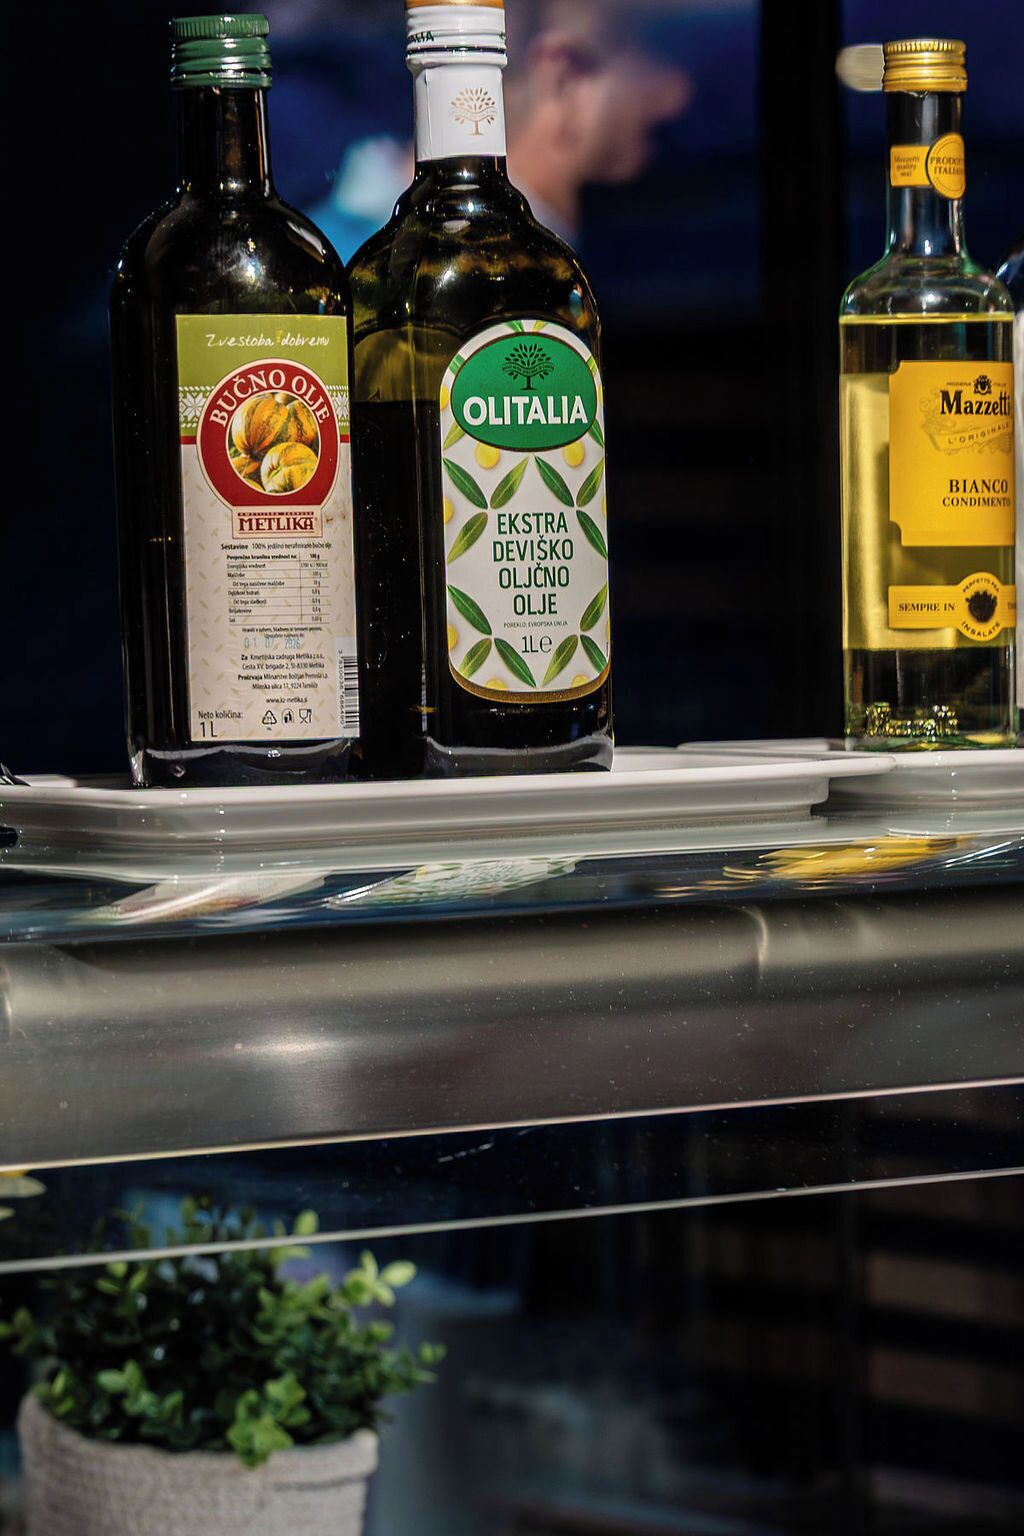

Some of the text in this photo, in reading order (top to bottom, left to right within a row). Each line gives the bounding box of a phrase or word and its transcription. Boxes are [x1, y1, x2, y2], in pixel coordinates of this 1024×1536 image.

[205, 332, 330, 348] Zvestoba dobremu
[209, 369, 330, 427] BUČNO OLJE
[940, 390, 1011, 416] Mazzetti
[462, 395, 589, 426] OLITALIA
[949, 479, 1009, 494] BIANCO
[238, 517, 314, 531] METLIKA
[497, 512, 569, 535] EKSTRA
[221, 543, 249, 551] Sestavine
[493, 535, 574, 562] DEVIŠKO
[498, 562, 570, 589] OLJČNO
[513, 594, 558, 616] OLJE
[898, 602, 955, 612] SEMPRE IN
[960, 621, 1001, 639] INSALATE
[265, 663, 285, 672] brigade
[198, 709, 244, 720] Neto količina:
[199, 720, 218, 738] 1 L
